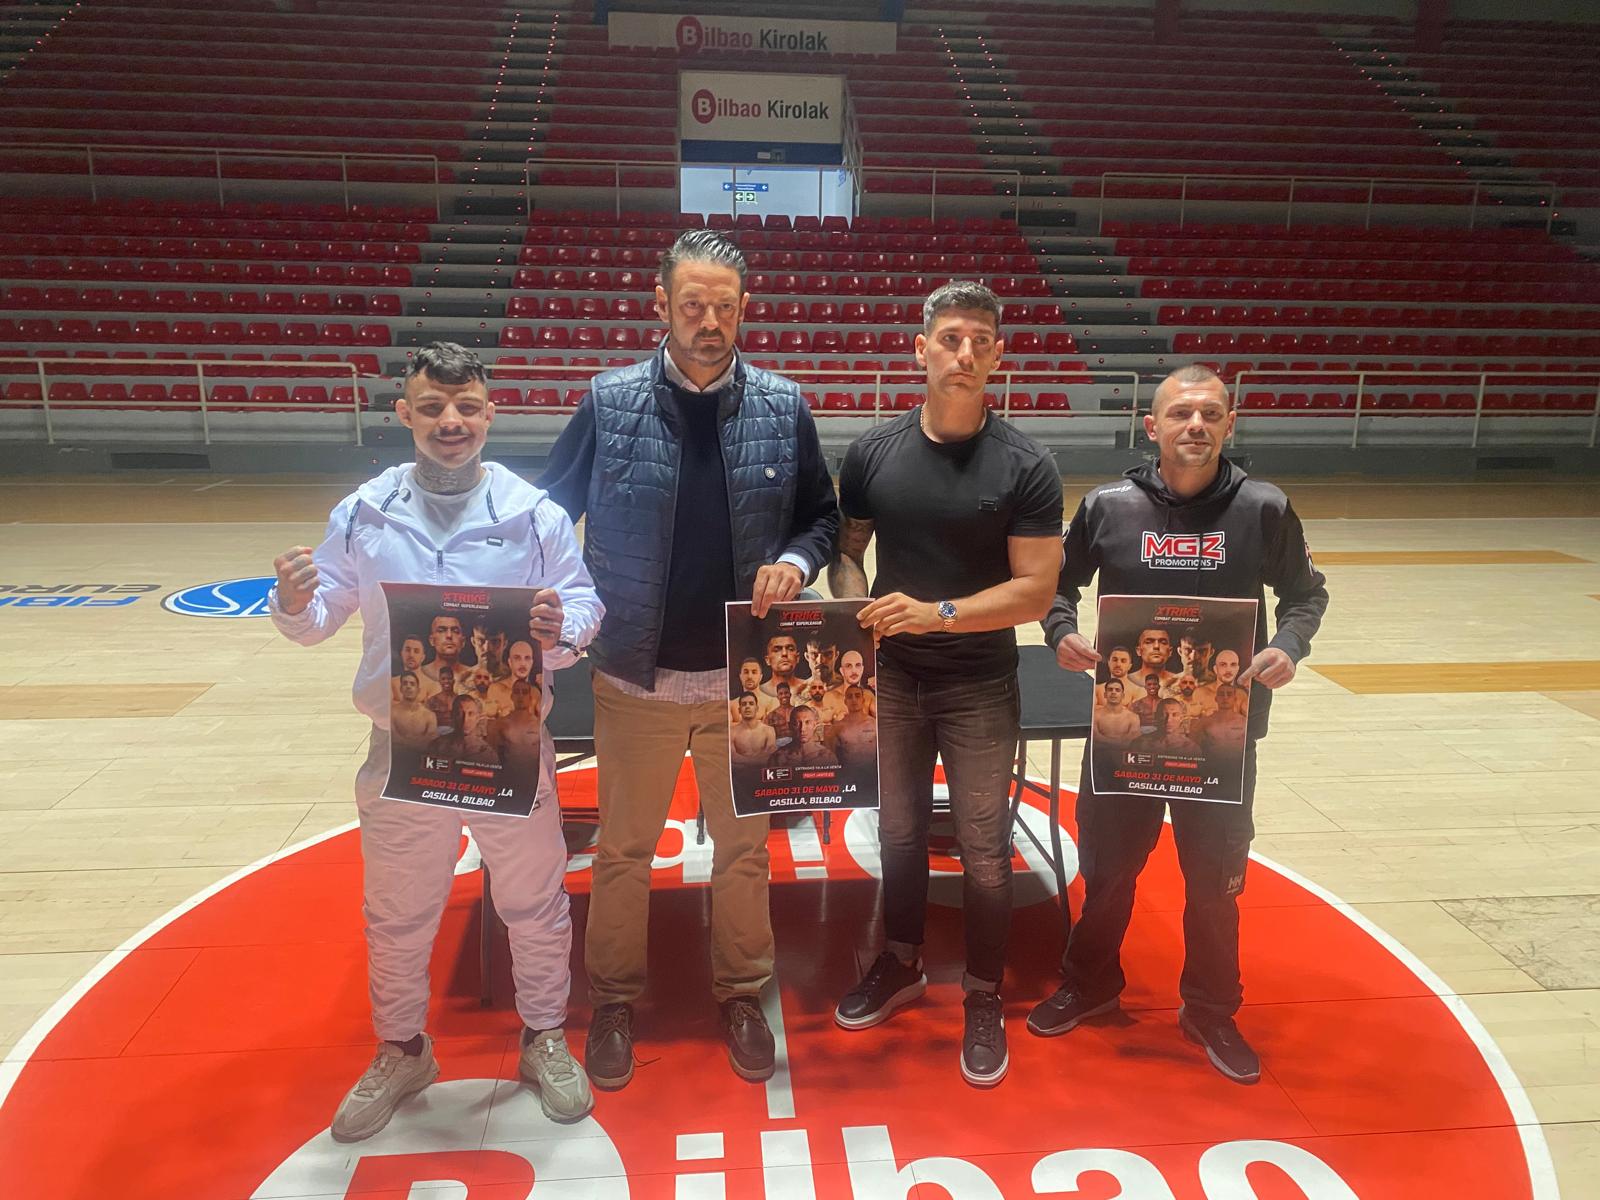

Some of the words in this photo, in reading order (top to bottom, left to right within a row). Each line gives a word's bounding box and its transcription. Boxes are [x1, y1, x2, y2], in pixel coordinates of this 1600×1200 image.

[679, 22, 752, 49] Bilbao
[759, 28, 828, 51] Kirolak
[695, 86, 761, 118] Bilbao
[767, 99, 829, 119] Kirolak
[1144, 534, 1223, 559] MGZ
[1154, 557, 1211, 567] PROMOTIONS
[1151, 773, 1161, 781] 31
[1163, 774, 1174, 782] DE
[1176, 775, 1201, 784] MAYO
[754, 787, 790, 797] SABADO
[790, 786, 800, 794] 31
[802, 786, 814, 794] DE
[815, 784, 840, 793] MAYO
[1128, 781, 1168, 792] CASILLA,
[1169, 785, 1203, 794] BILBAO
[421, 790, 460, 803] CASILLA,
[461, 795, 496, 807] BILBAO
[769, 797, 807, 807] CASILLA,
[809, 795, 842, 804] BILBAO
